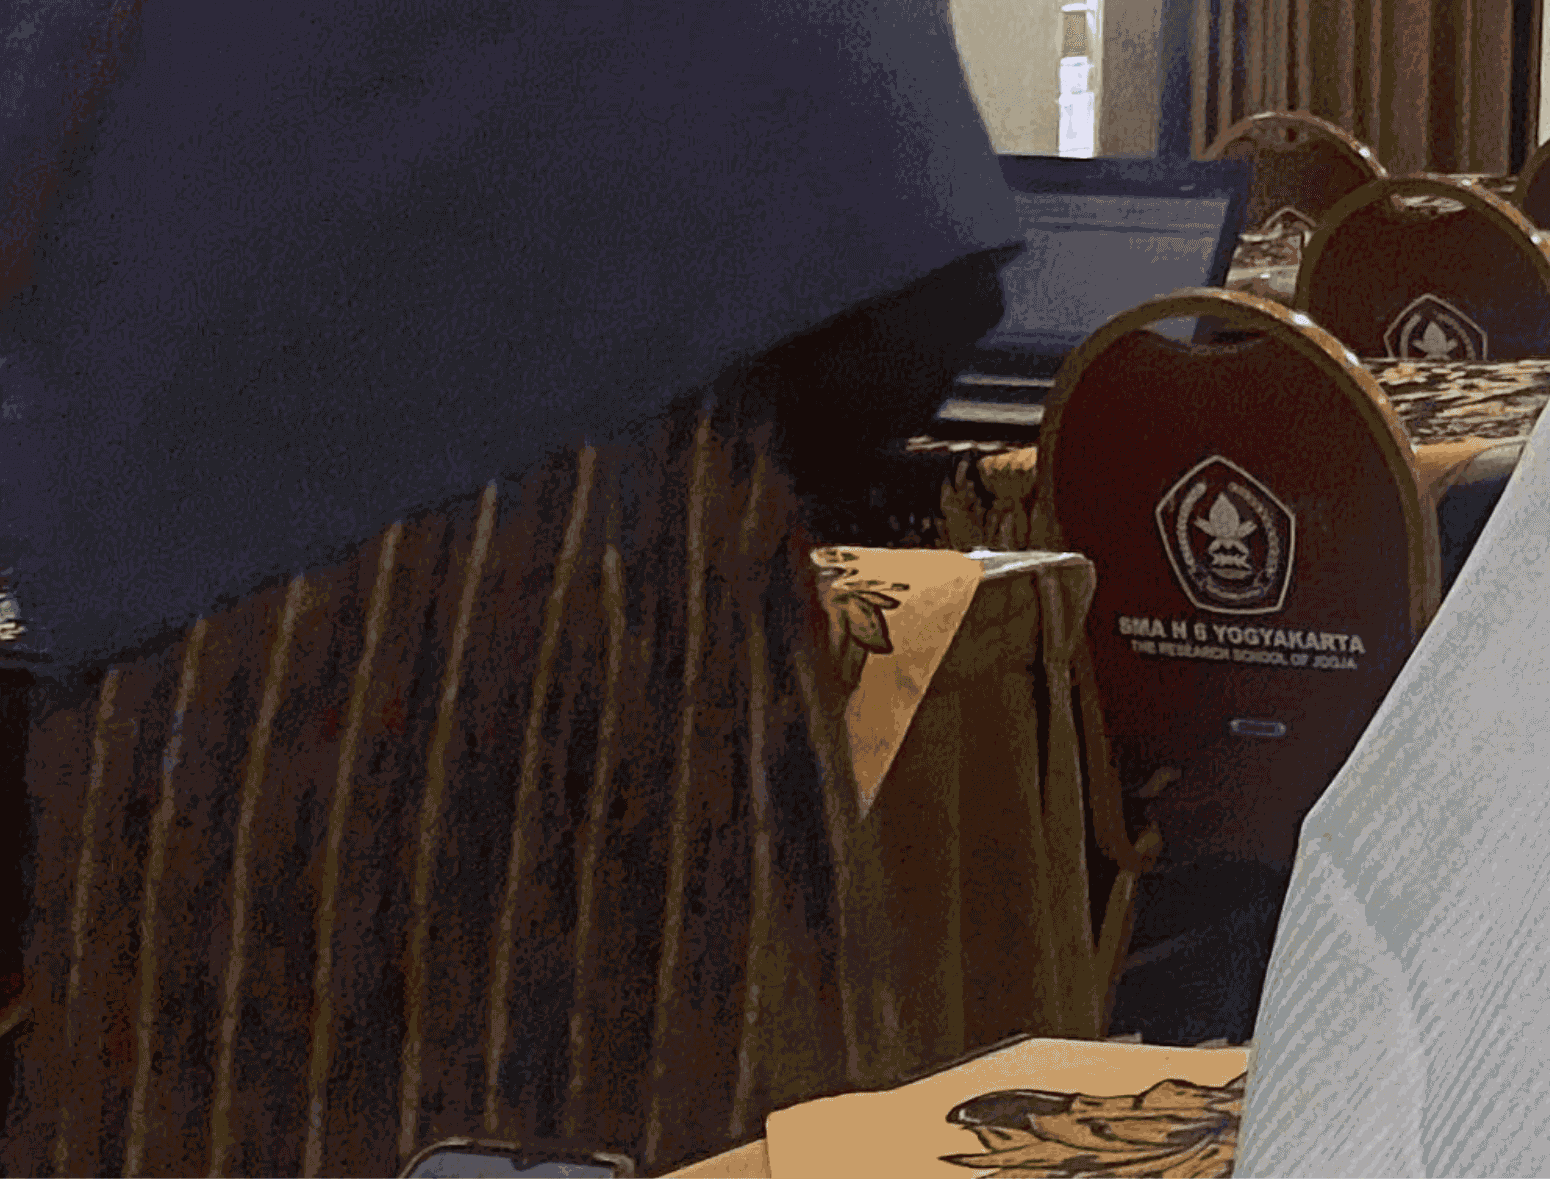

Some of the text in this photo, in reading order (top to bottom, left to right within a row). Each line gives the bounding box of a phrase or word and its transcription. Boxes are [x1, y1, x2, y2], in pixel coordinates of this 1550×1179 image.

[1118, 616, 1167, 638] SMA
[1212, 624, 1366, 655] YOGYAKARTA
[1131, 639, 1156, 655] THE
[1158, 641, 1231, 661] RESEARCH
[1233, 647, 1288, 665] SCHOOL
[1290, 653, 1310, 666] OF
